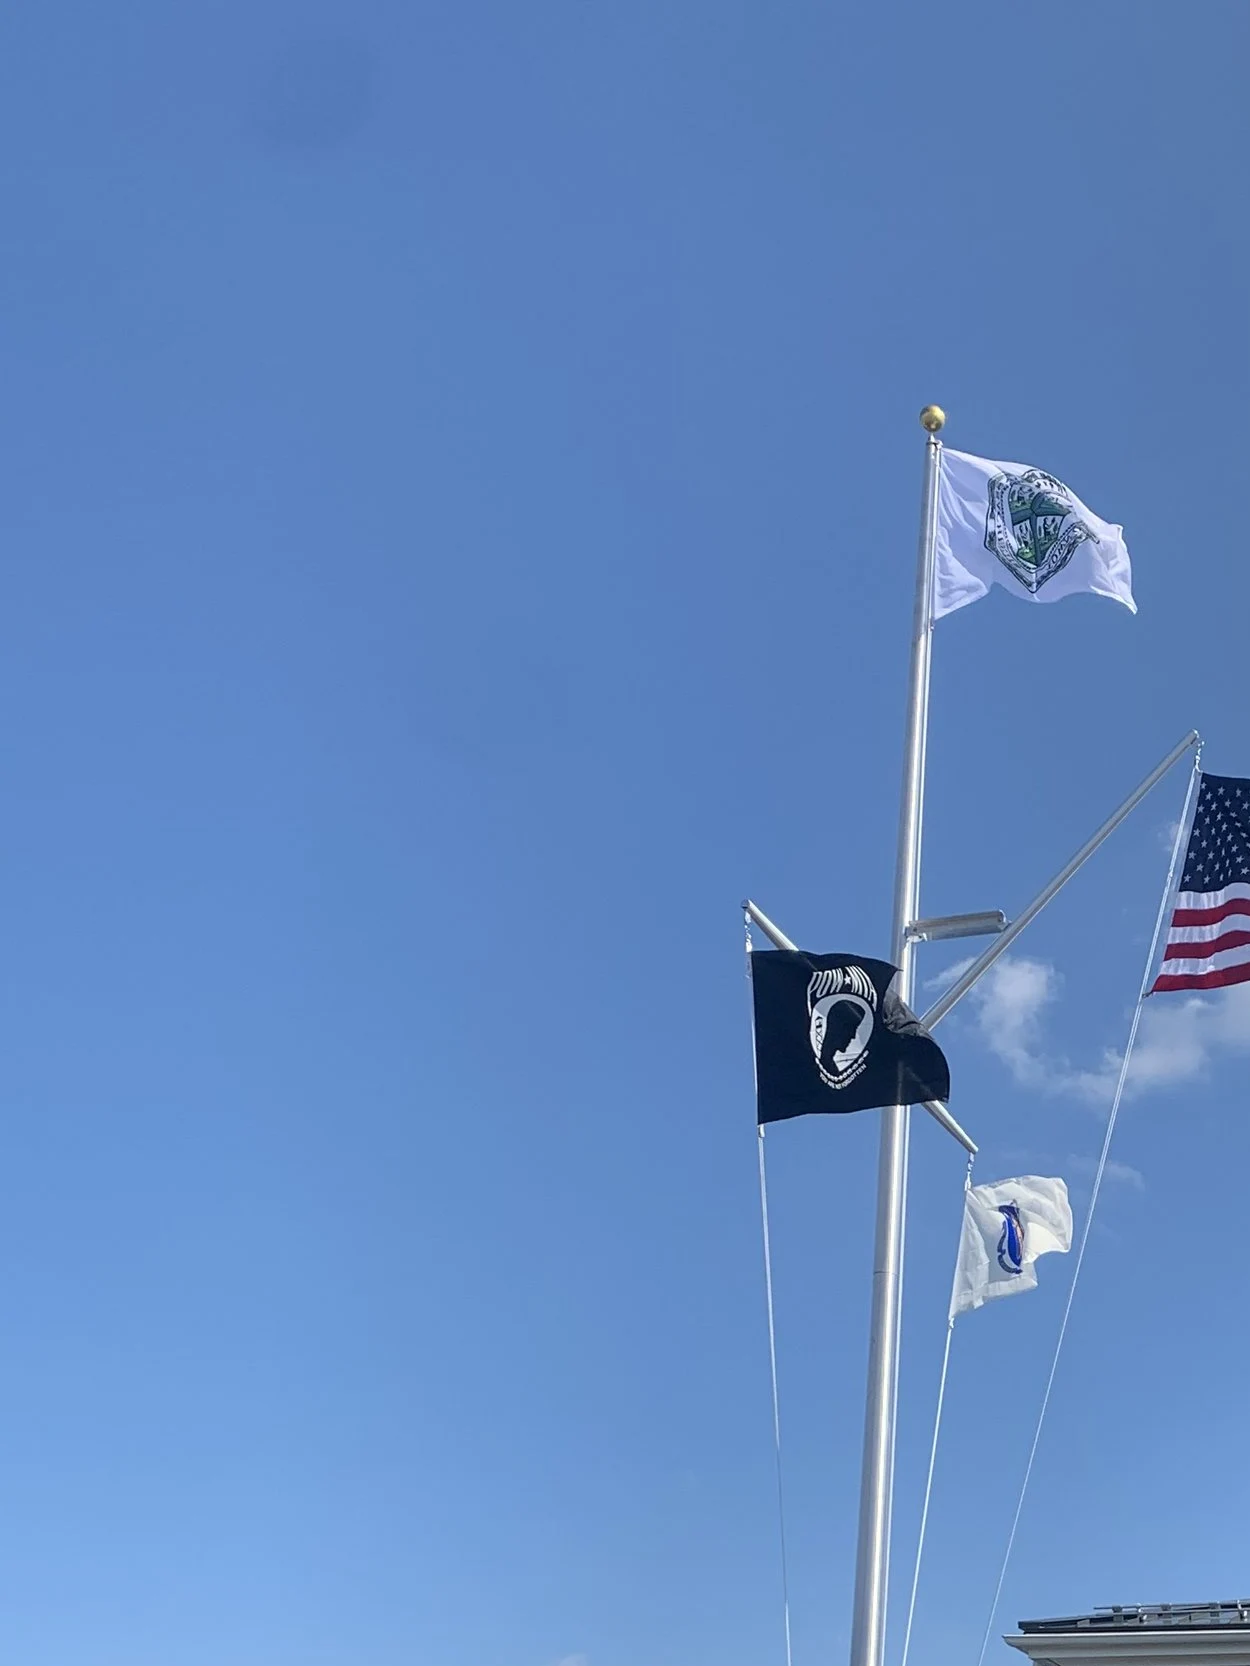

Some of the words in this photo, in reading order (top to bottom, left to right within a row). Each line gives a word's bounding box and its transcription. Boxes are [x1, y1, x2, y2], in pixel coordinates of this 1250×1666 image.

[807, 967, 844, 1017] POW
[844, 965, 878, 1012] MIA
[841, 1063, 867, 1088] FORGOTTEN
